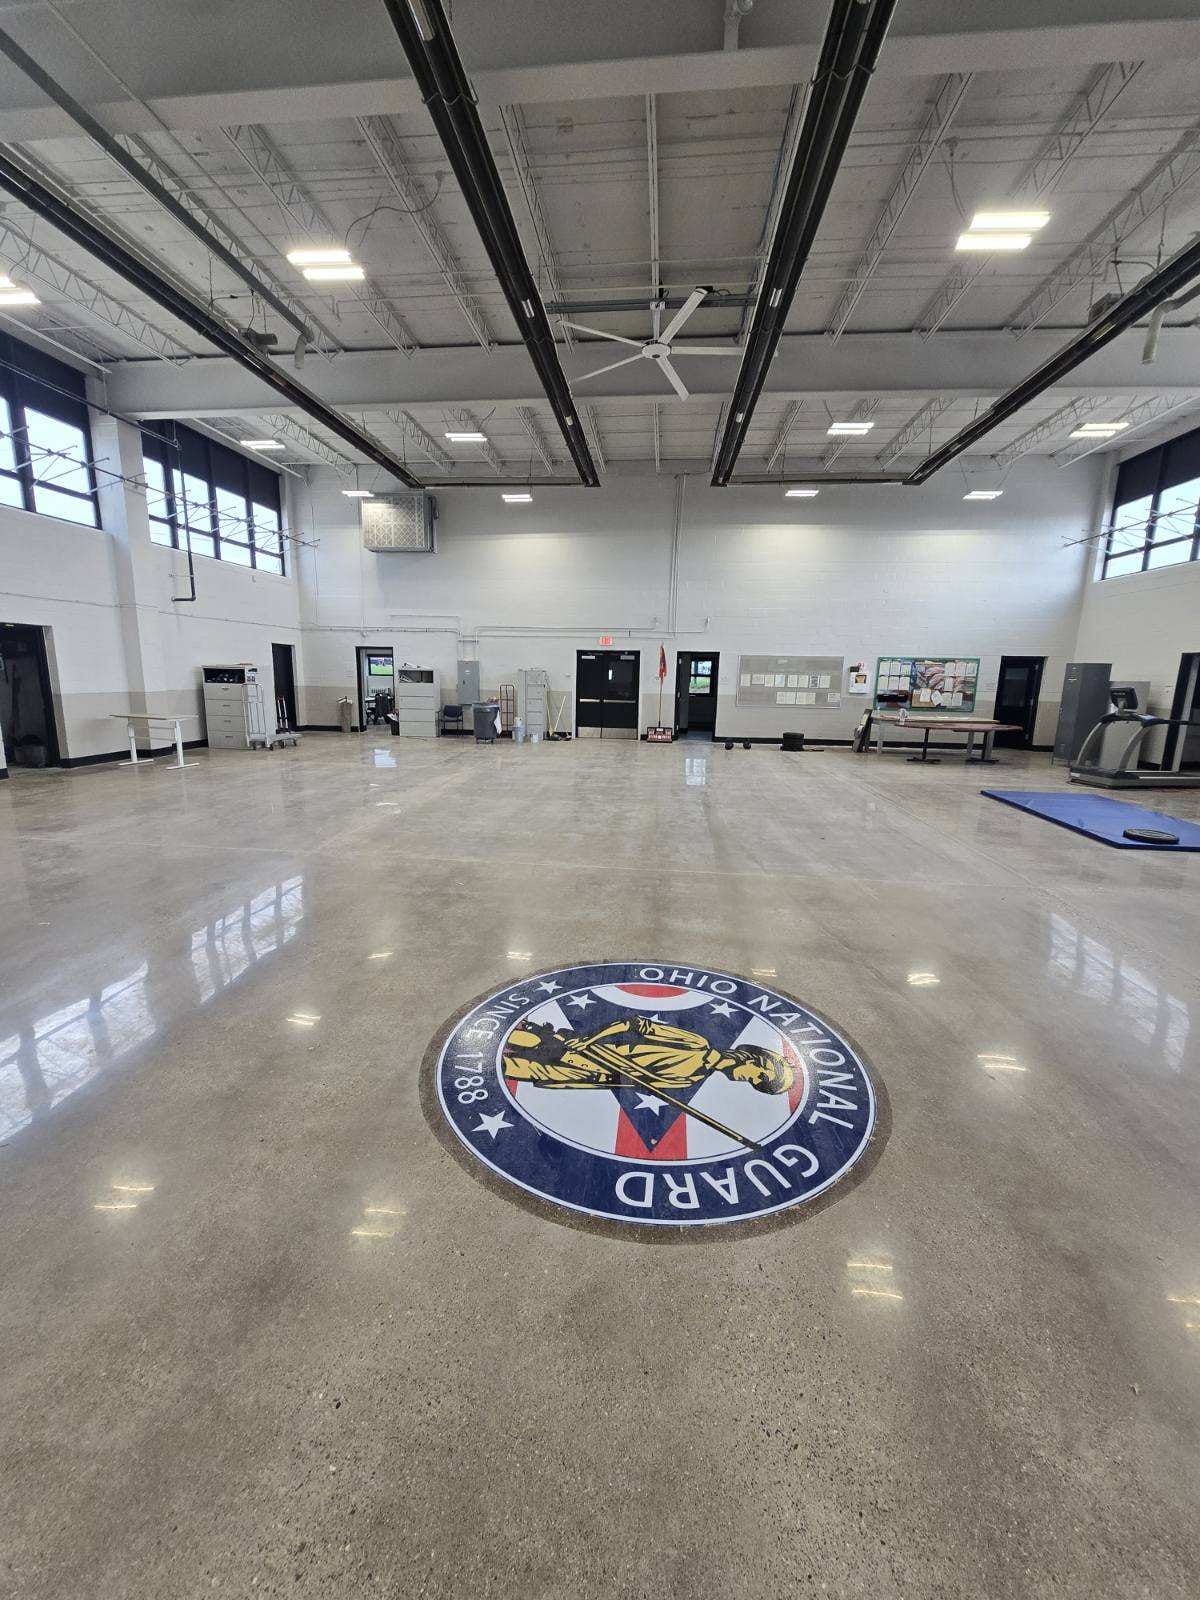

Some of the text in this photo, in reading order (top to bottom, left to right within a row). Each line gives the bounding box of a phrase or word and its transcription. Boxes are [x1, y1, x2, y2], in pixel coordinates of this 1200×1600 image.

[454, 993, 530, 1105] SINCE 1788
[614, 967, 858, 1210] OHIO NATIONAL GUARD
